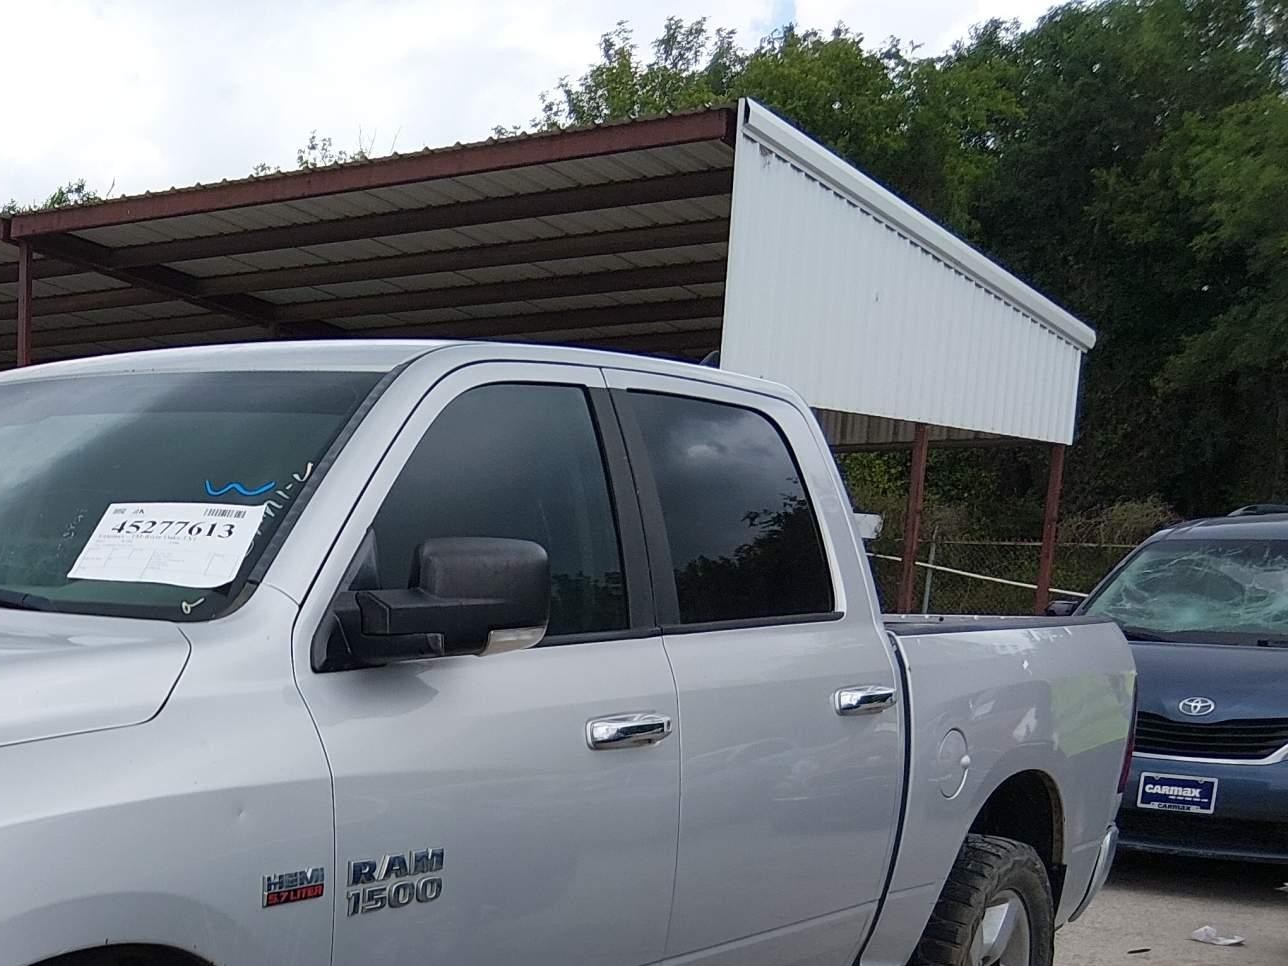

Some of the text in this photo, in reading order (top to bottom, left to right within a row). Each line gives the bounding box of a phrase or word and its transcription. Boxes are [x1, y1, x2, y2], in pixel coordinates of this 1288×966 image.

[111, 520, 235, 539] 45277613
[262, 866, 325, 892] HEMI
[347, 848, 444, 887] RAM
[267, 885, 323, 905] 5.7 LITER
[347, 876, 443, 916] 1500
